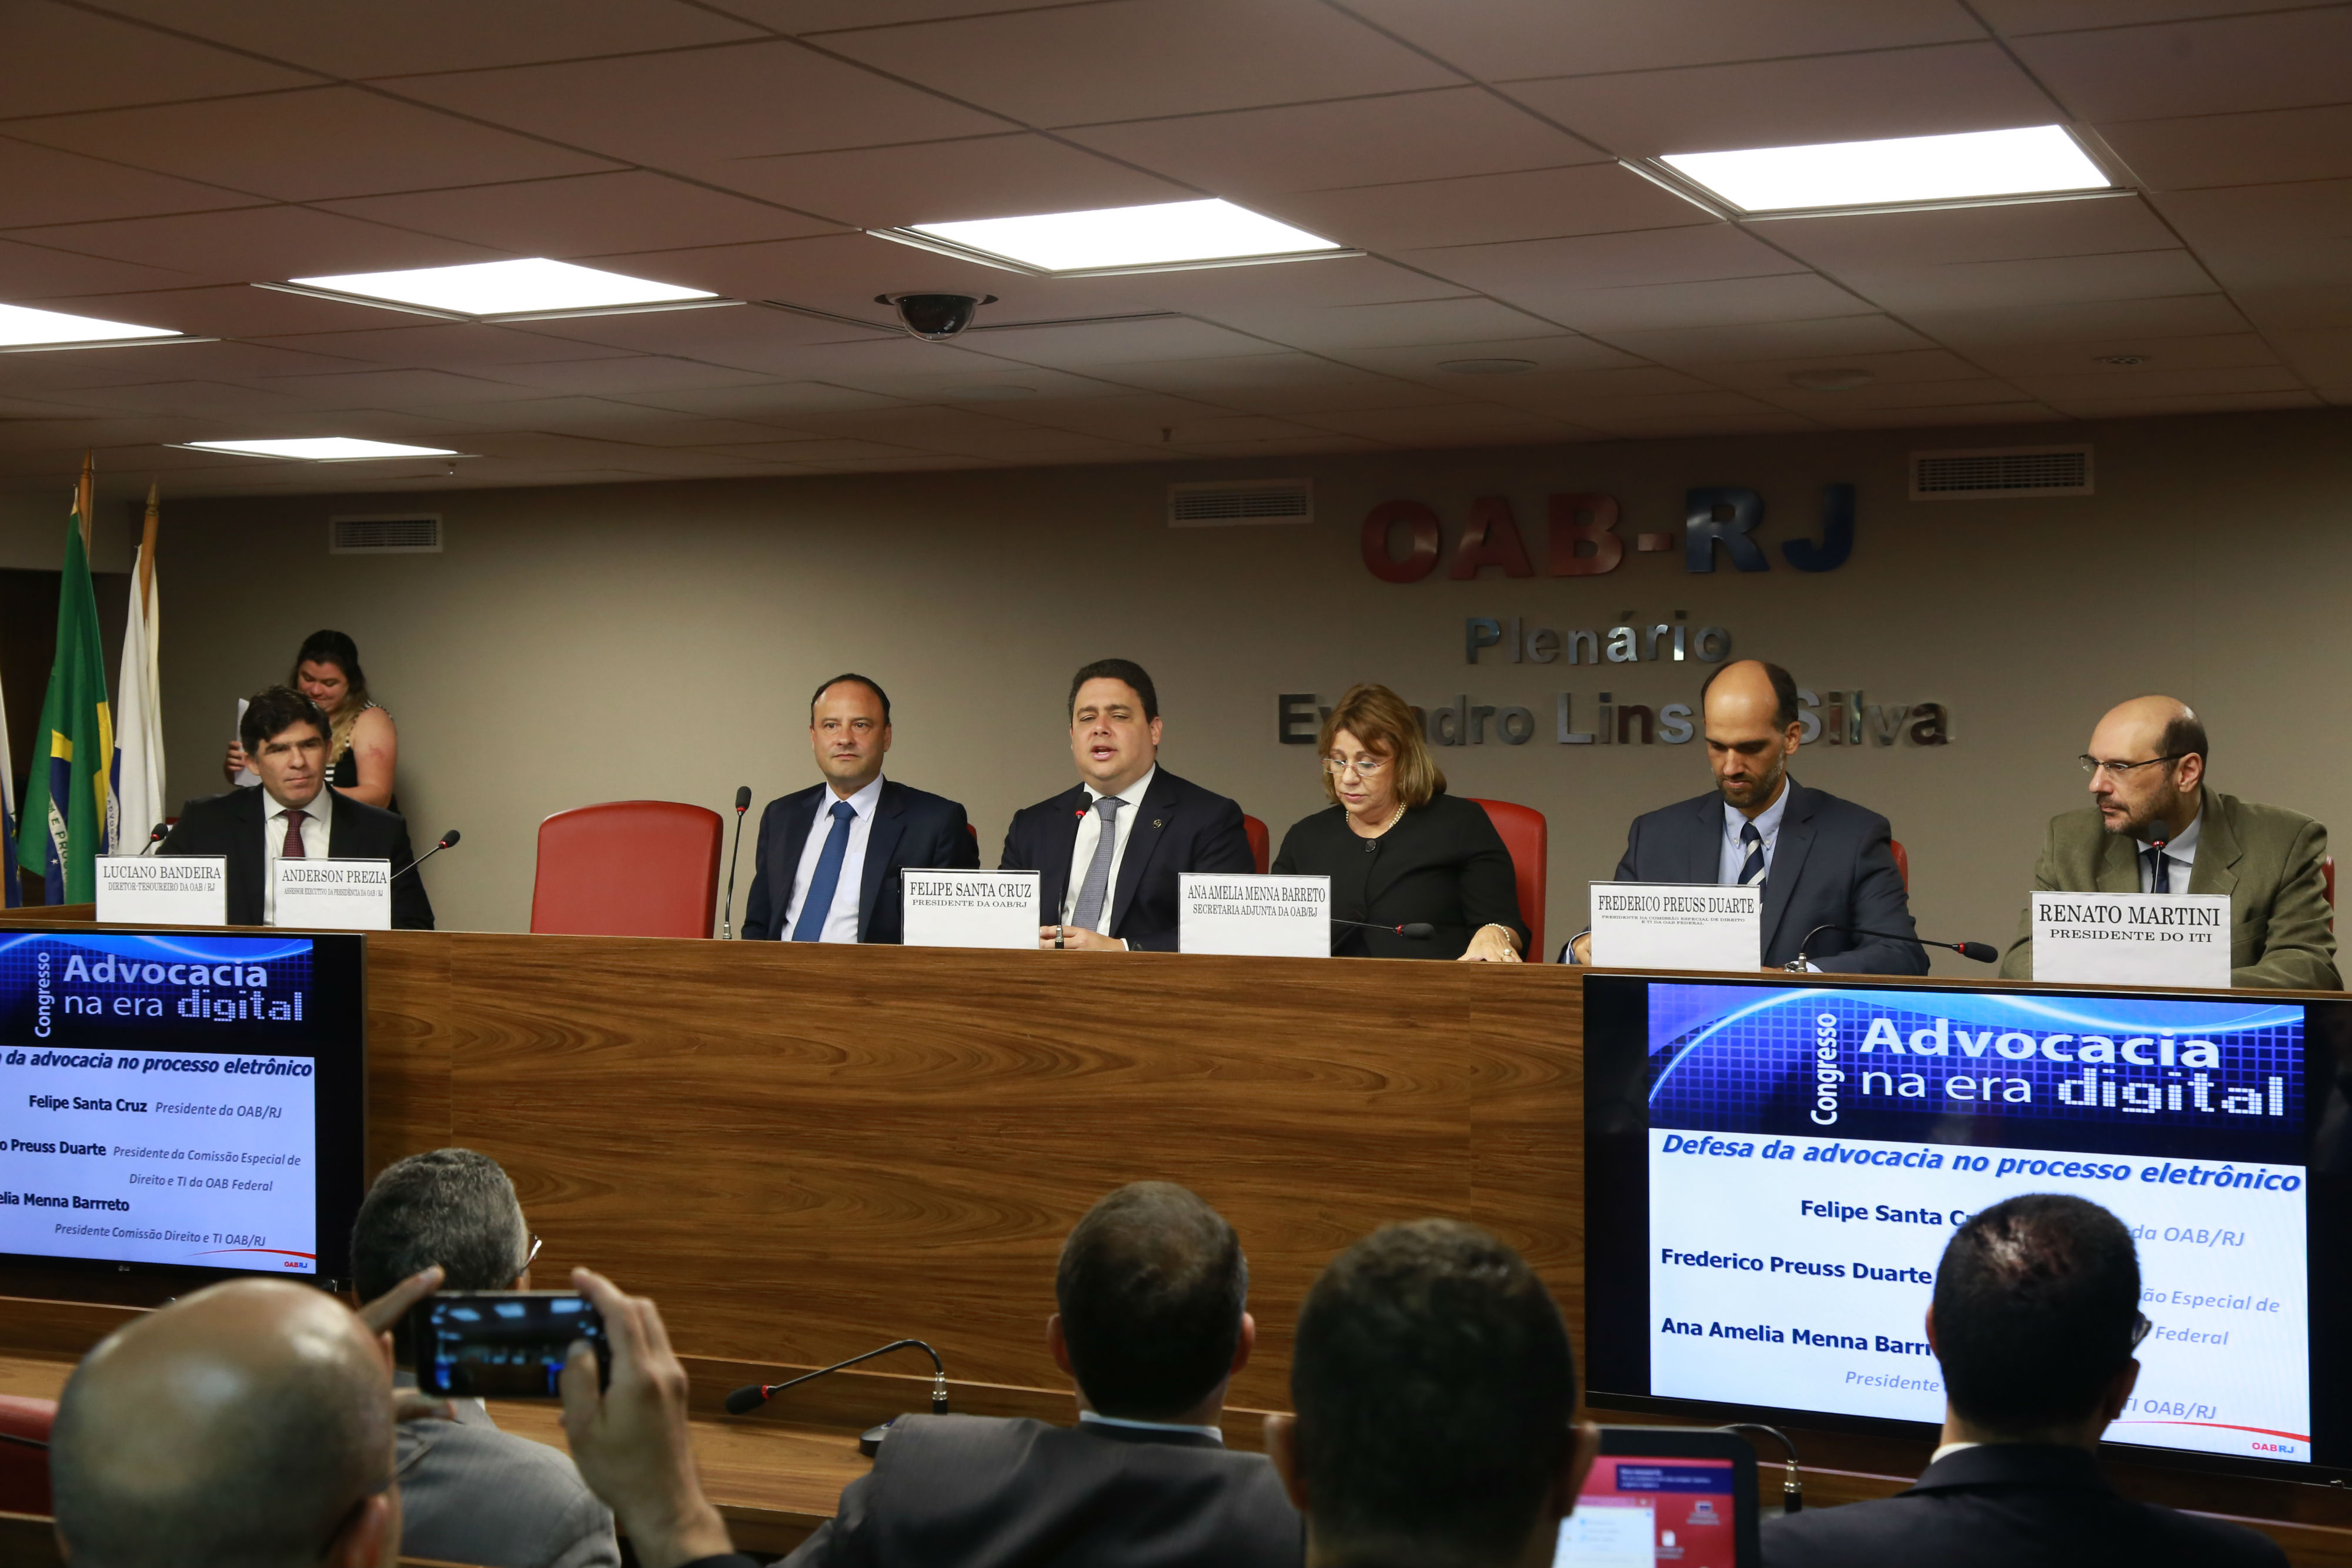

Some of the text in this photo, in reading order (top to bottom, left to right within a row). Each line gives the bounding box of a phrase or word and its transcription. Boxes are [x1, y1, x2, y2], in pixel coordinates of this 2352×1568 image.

[1361, 483, 1856, 584] OAB-RJ
[1465, 610, 1732, 665] Plenário
[1557, 691, 1694, 745] Lins
[1797, 689, 1956, 745] Silva
[103, 865, 222, 879] LUCIANO BANDEIRA
[282, 869, 387, 884] ANDERSON PREZIA
[108, 882, 178, 891] DIRETOR-TESOUREIRO
[179, 882, 189, 891] DA
[191, 882, 203, 891] OAB
[208, 883, 215, 892] RJ
[910, 882, 1031, 898] FELIPE SANTA CRUZ
[1188, 885, 1325, 902] ANA AMELIA MENNA BARRETO
[1193, 904, 1317, 917] SECRETARIA ADJUNTA DA OAB/RJ
[1598, 895, 1754, 914] FREDERICO PREUSS DUARTE
[2039, 904, 2220, 926] RENATO MARTINI
[2050, 929, 2212, 942] PRESIDENTE DO ITI
[63, 954, 268, 987] Advocacia
[34, 951, 55, 1038] Congresso
[65, 989, 302, 1022] na era digital
[1860, 1018, 2220, 1069] Advocacia
[5, 1049, 26, 1065] da
[30, 1051, 113, 1069] advocacia
[117, 1057, 139, 1069] no
[142, 1057, 219, 1074] processo
[224, 1058, 312, 1076] eletrônico
[1810, 1012, 1845, 1125] Congresso
[1862, 1068, 2284, 1117] na era digital
[29, 1095, 282, 1119] Felipe Santa Cruz Presidente da OAB/RJ
[11, 1139, 56, 1154] Preuss
[59, 1141, 106, 1156] Duarte
[113, 1146, 169, 1159] Presidente
[171, 1149, 185, 1160] da
[188, 1150, 239, 1162] Comissão
[241, 1153, 285, 1166] Especial
[288, 1155, 301, 1165] de
[1662, 1134, 2301, 1192] Defesa da advocacia no processo eletrônico
[129, 1174, 273, 1192] Direito e TI da OAB Federal
[0, 1191, 129, 1211] elia Menna Barrreto
[55, 1223, 265, 1248] Presidente Comissão Direito e TI OAB/RJ
[1800, 1199, 1869, 1223] Felipe
[1876, 1204, 1942, 1225] Santa
[2132, 1224, 2157, 1240] da
[2164, 1227, 2246, 1248] OAB/RJ
[284, 1261, 308, 1269] OABRJ
[1661, 1248, 1764, 1272] Frederico
[1770, 1256, 1846, 1278] Preuss
[1852, 1262, 1933, 1285] Duarte
[2171, 1290, 2251, 1310] Especial
[2256, 1297, 2280, 1313] de
[1661, 1317, 1703, 1336] Ana
[1709, 1321, 1785, 1344] Amelia
[1792, 1328, 1868, 1350] Menna
[2155, 1326, 2229, 1346] Federal
[1845, 1370, 1940, 1393] Presidente
[2144, 1400, 2217, 1420] OAB/RJ
[2252, 1442, 2294, 1454] OABRJ
